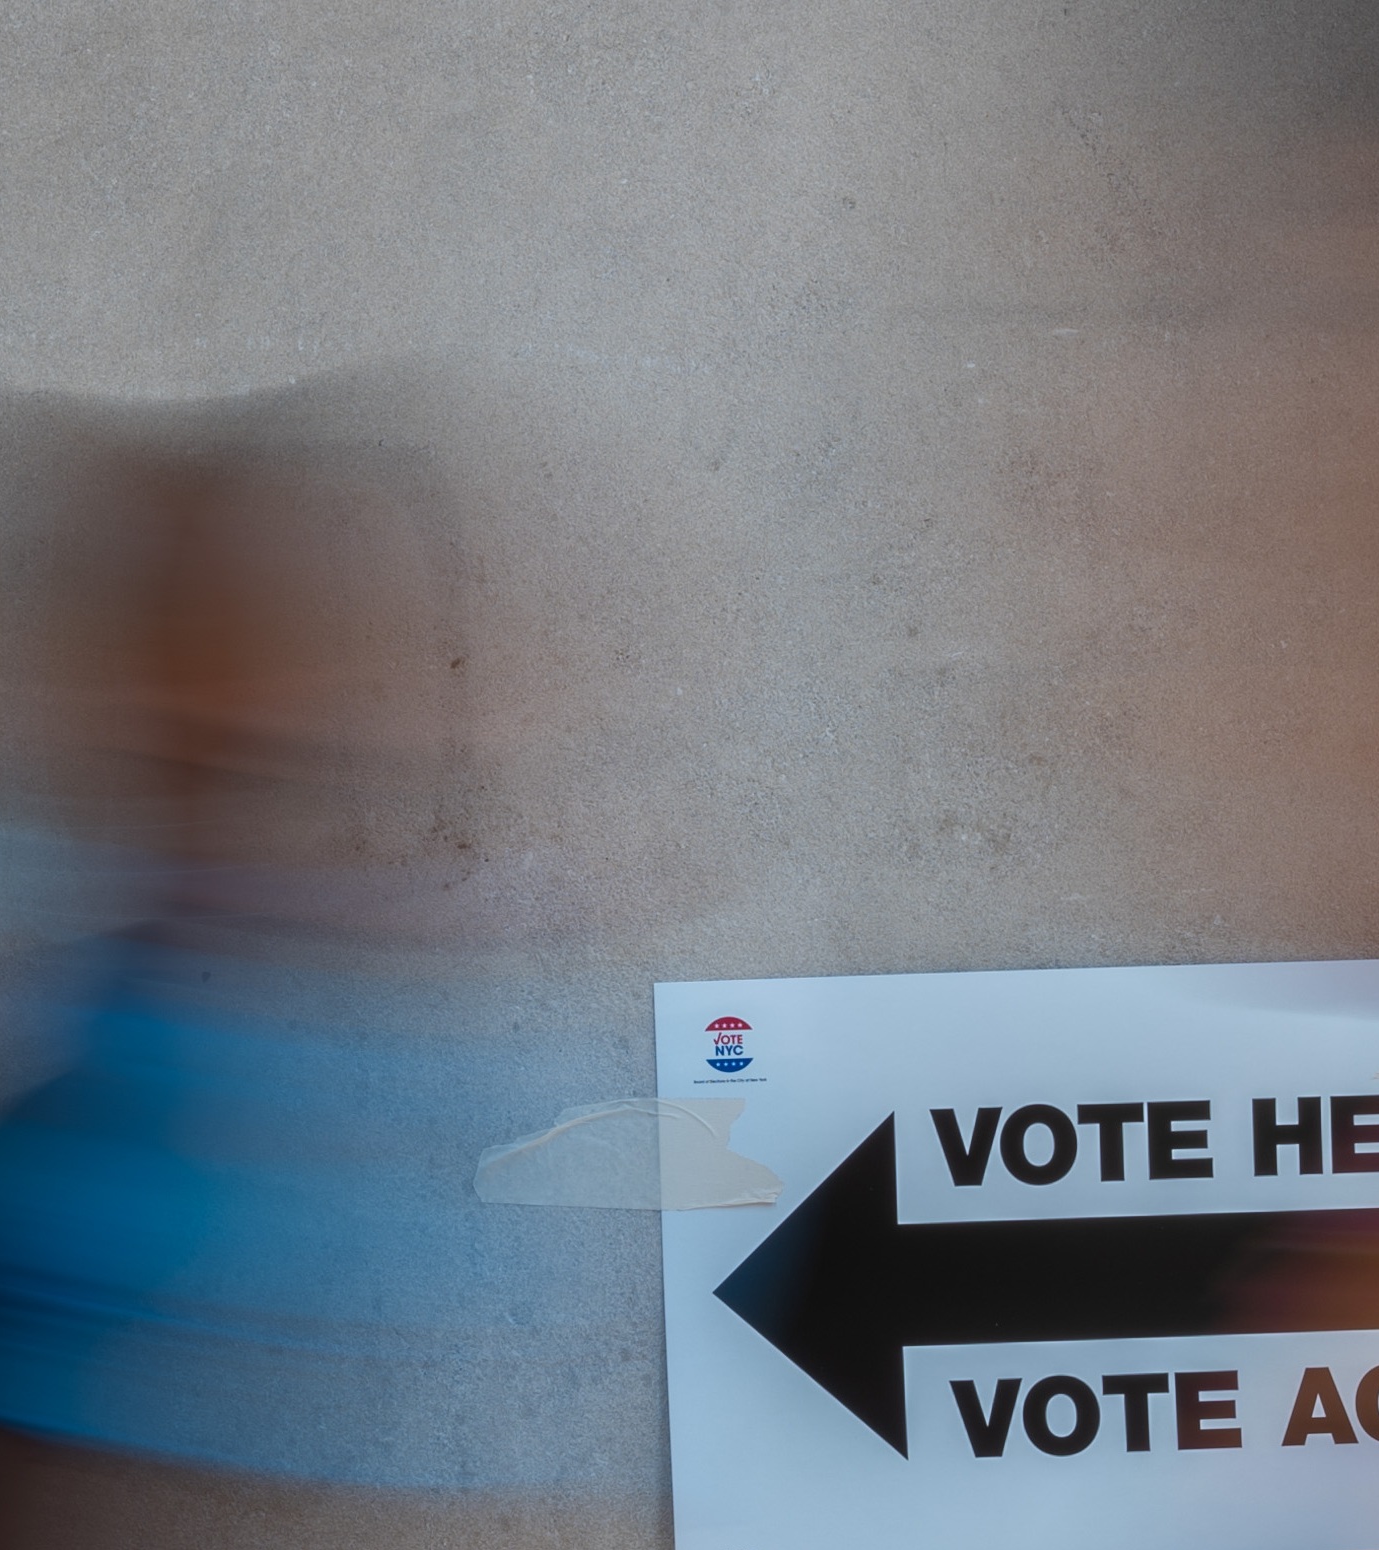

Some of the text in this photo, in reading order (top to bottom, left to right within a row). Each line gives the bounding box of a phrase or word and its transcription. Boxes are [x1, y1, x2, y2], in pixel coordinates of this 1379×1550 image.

[715, 1045, 744, 1056] NYC
[929, 1100, 1214, 1187] VOTE
[948, 1370, 1243, 1458] VOTE
